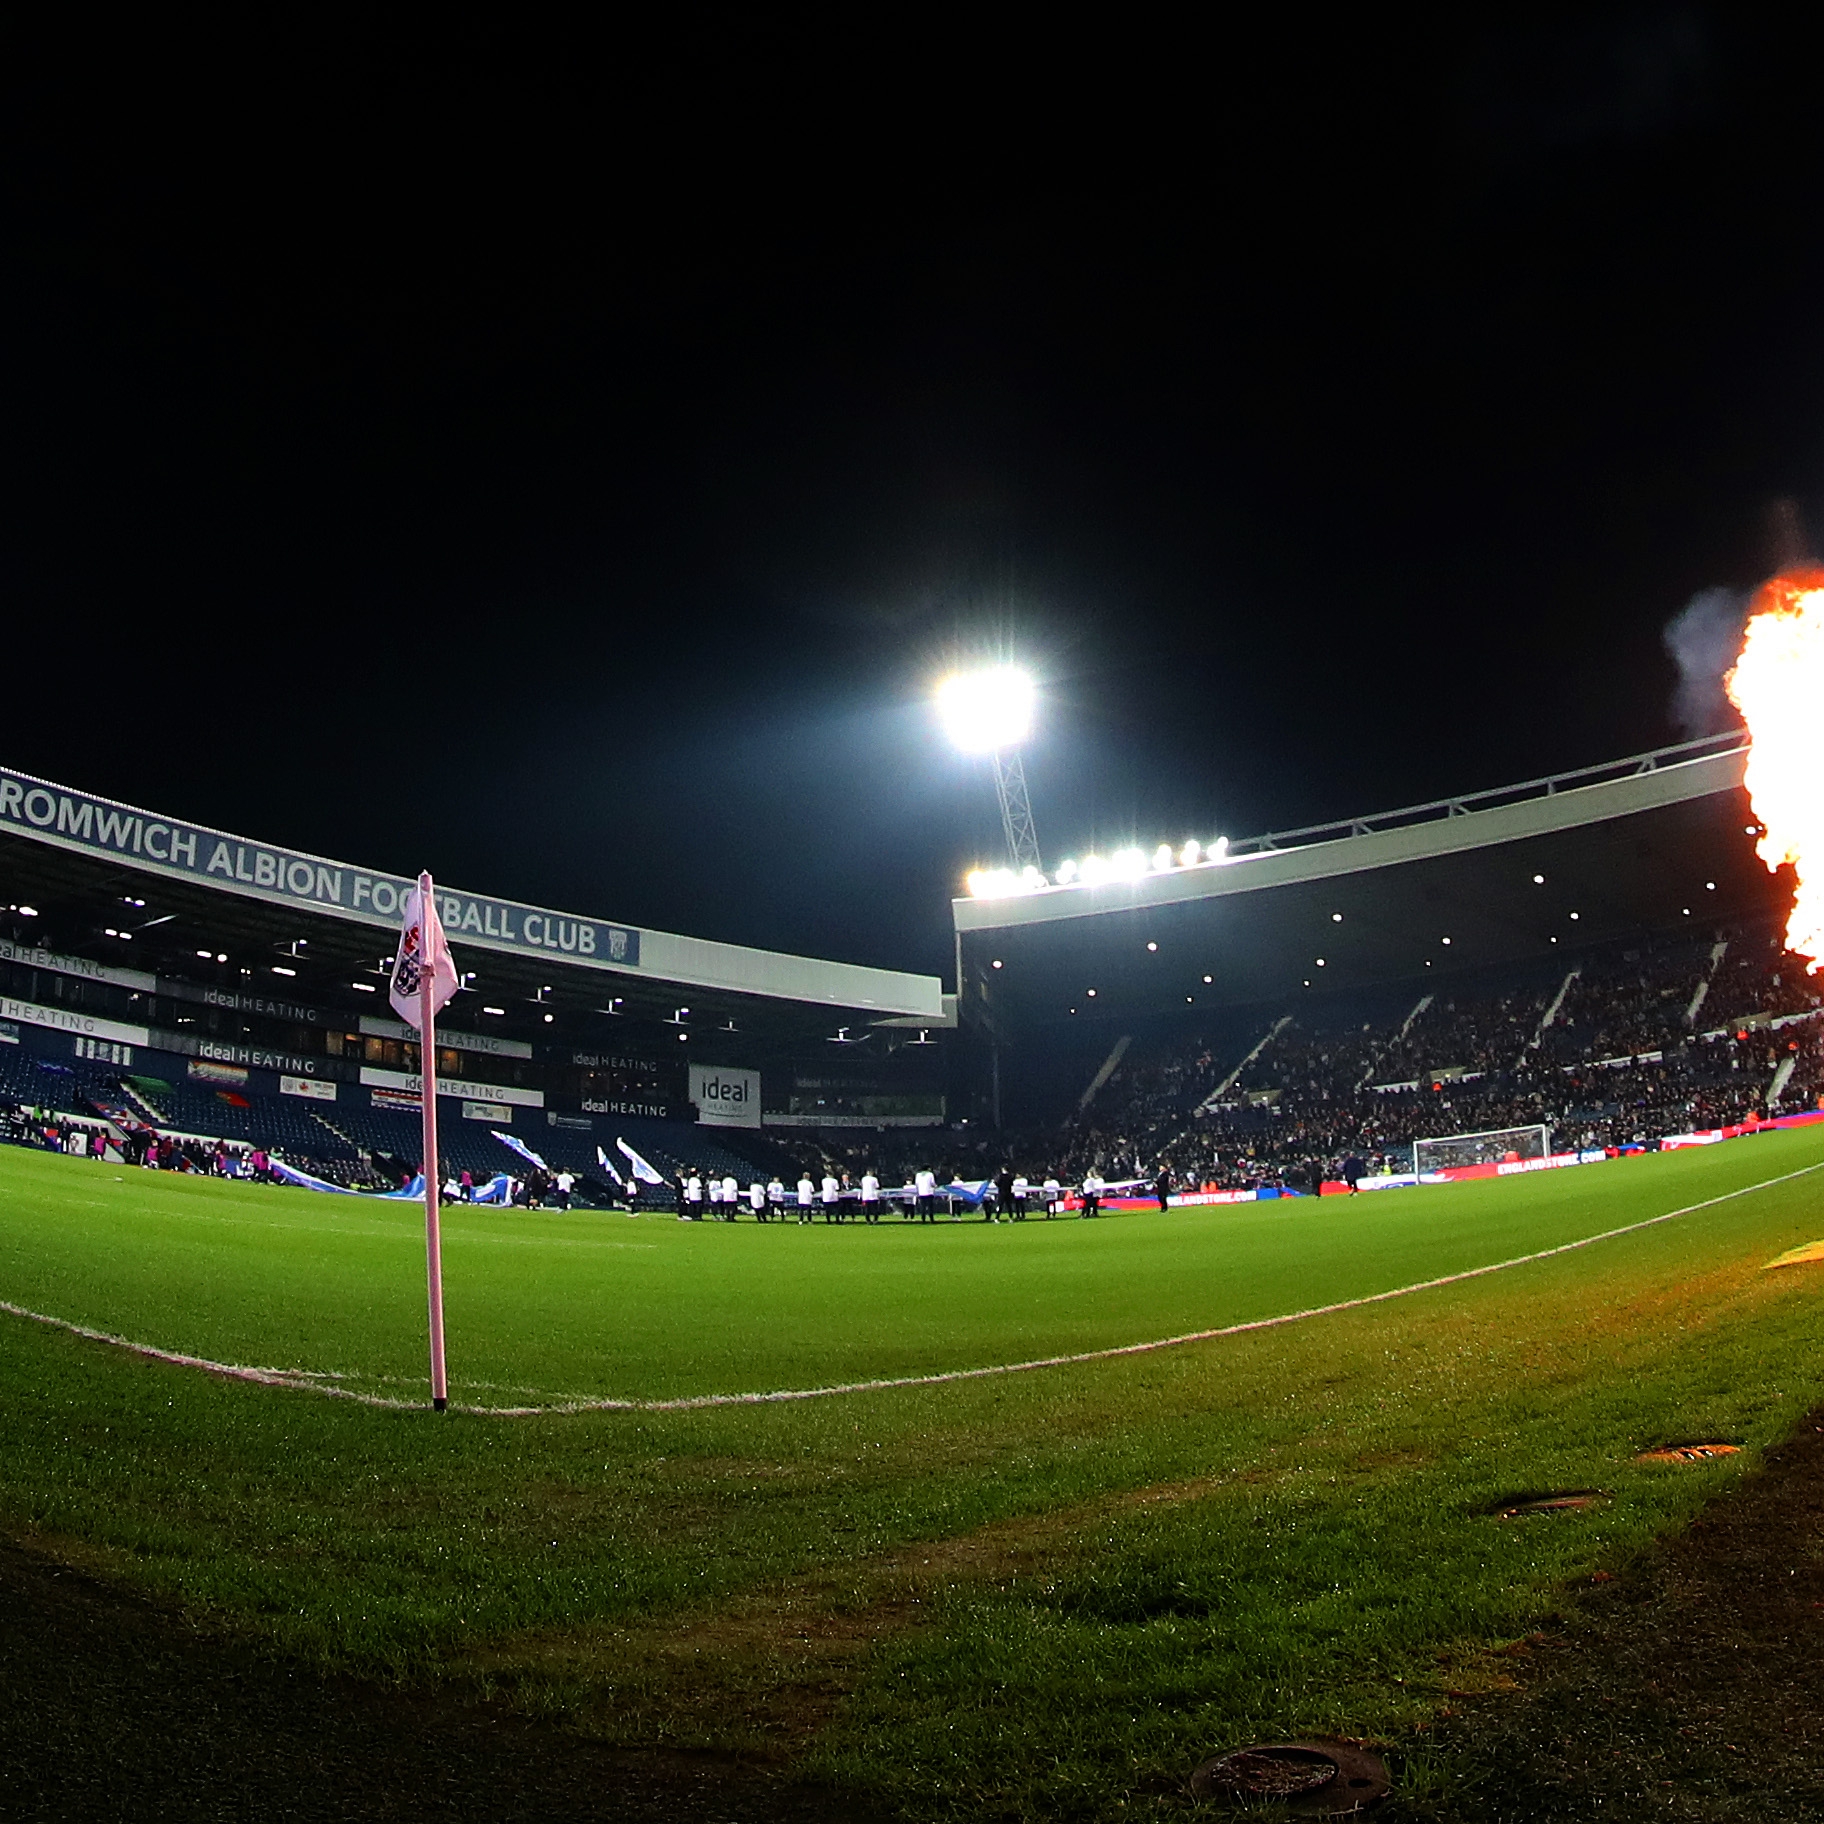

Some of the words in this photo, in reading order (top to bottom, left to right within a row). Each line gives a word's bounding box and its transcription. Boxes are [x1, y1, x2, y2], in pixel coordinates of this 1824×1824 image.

[207, 841, 343, 904] ALBION
[353, 877, 516, 940] FOBALL
[524, 915, 596, 955] CLUB
[22, 949, 106, 978] HEATING
[8, 998, 95, 1033] HEATING
[204, 989, 239, 1008] ideal
[243, 997, 317, 1021] HEATING
[437, 1030, 500, 1051] HEATING
[199, 1041, 235, 1061] ideal
[239, 1049, 315, 1074] HEATING
[602, 1056, 658, 1072] HEATING
[439, 1080, 505, 1100] HEATING
[703, 1076, 748, 1102] ideal
[582, 1099, 608, 1113] ideal
[610, 1101, 667, 1117] HEATING
